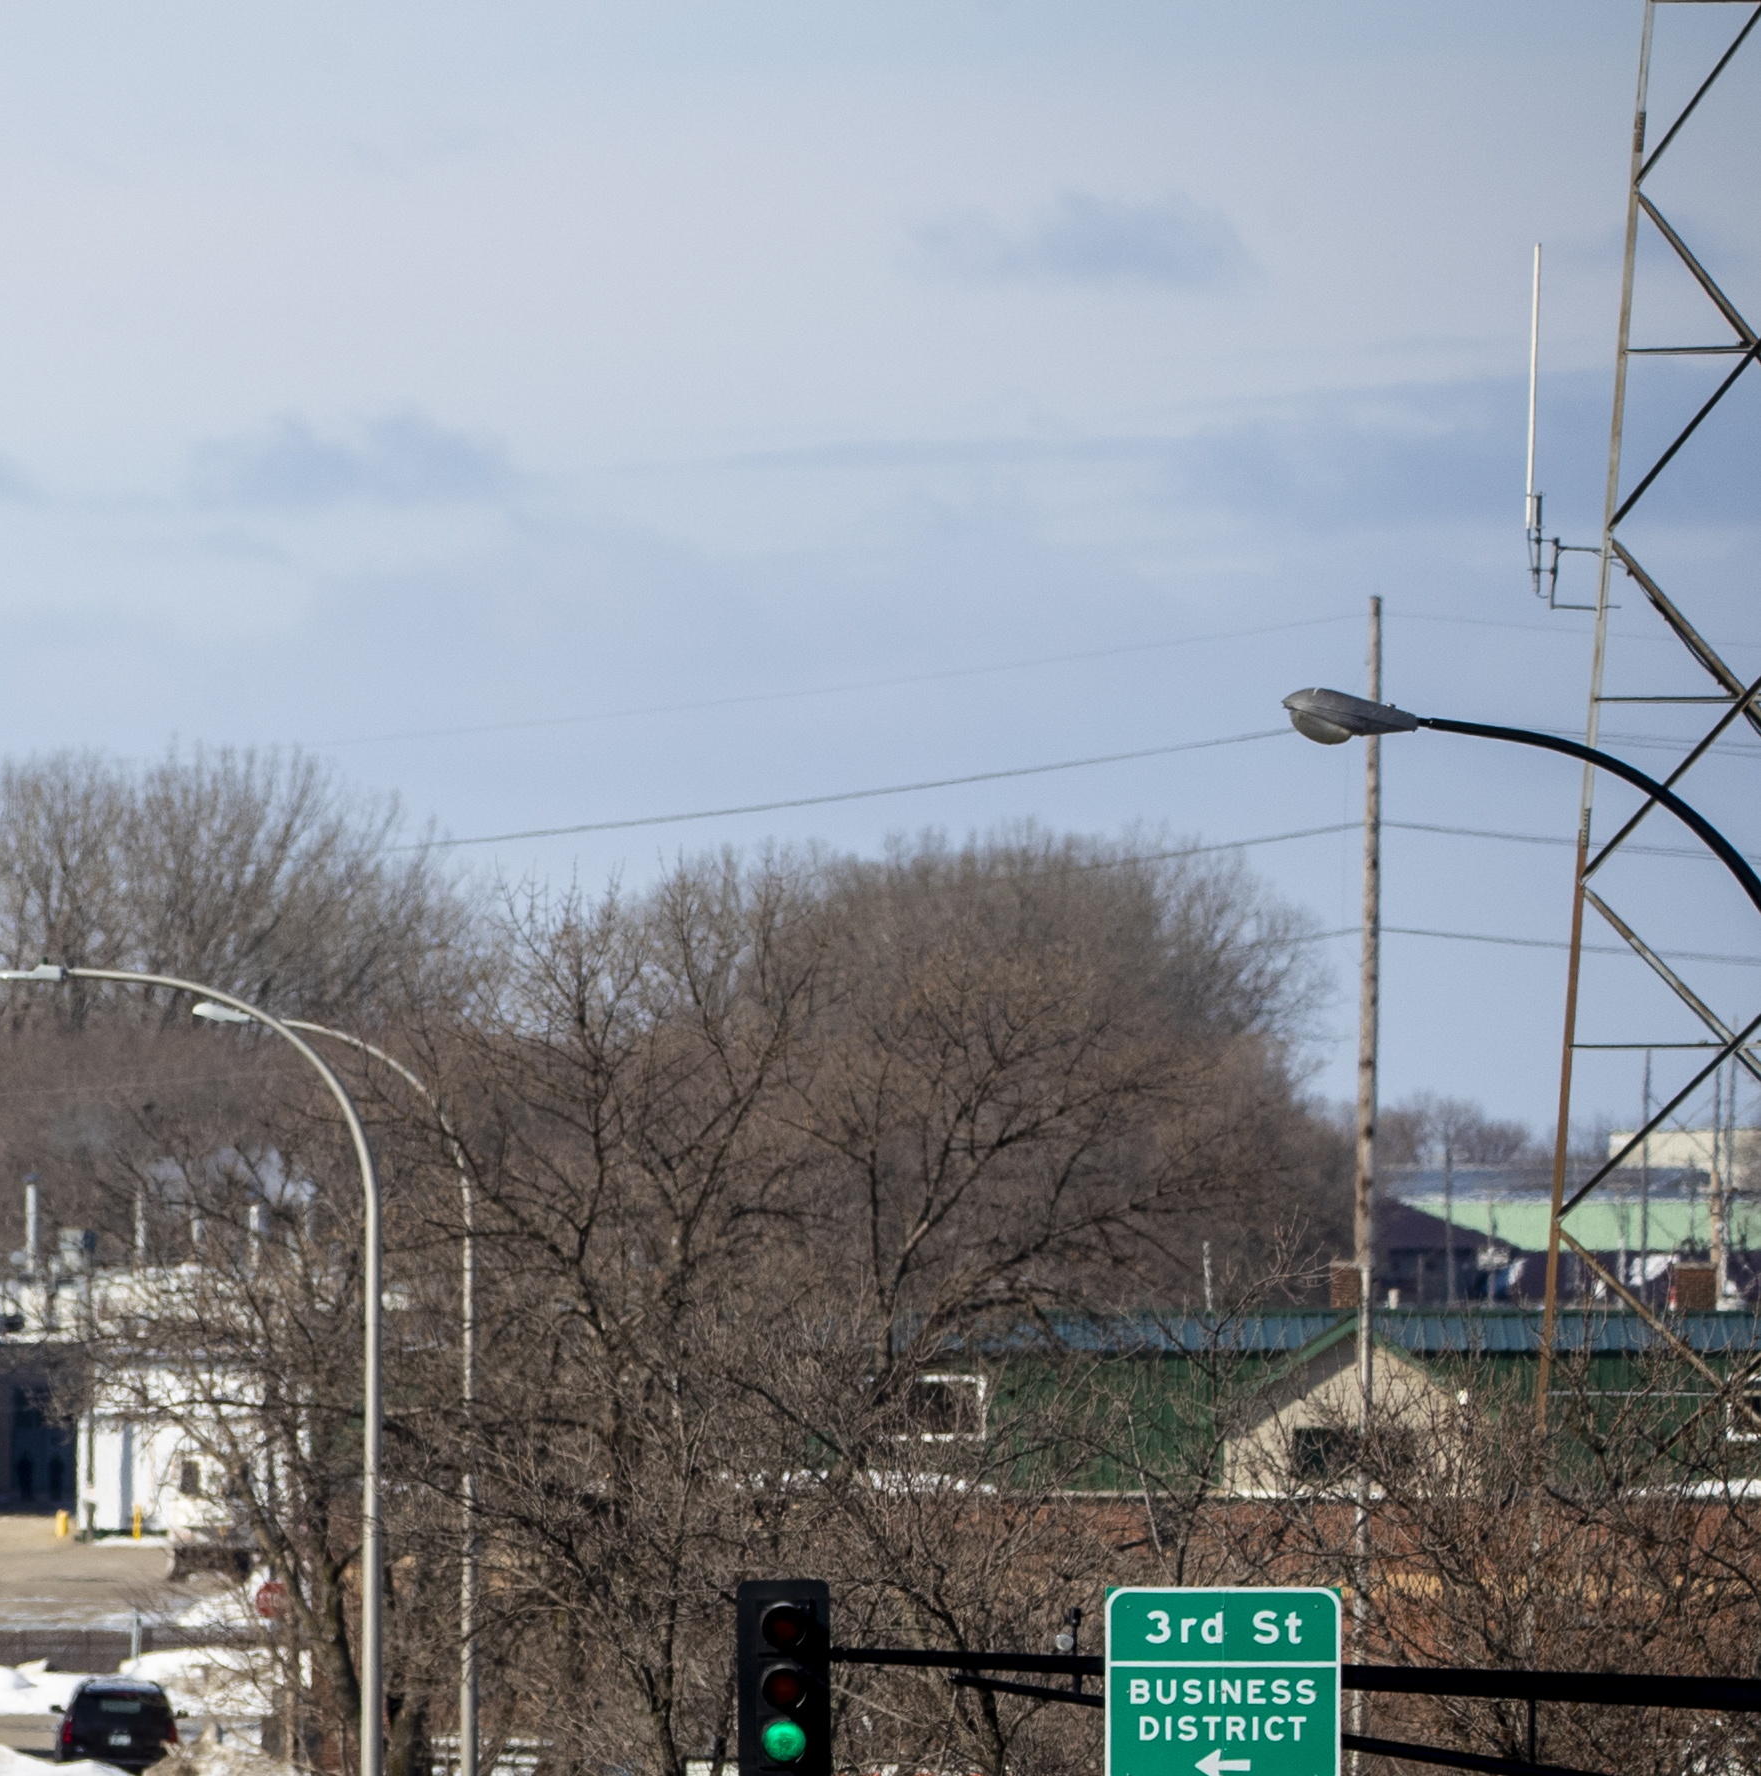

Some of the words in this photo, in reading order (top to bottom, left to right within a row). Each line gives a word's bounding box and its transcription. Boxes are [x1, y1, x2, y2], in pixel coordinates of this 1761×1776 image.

[1145, 1610, 1224, 1644] 3rd
[1252, 1610, 1303, 1644] St
[1130, 1678, 1317, 1705] BUSINESS
[1139, 1715, 1307, 1741] DISTRICT
